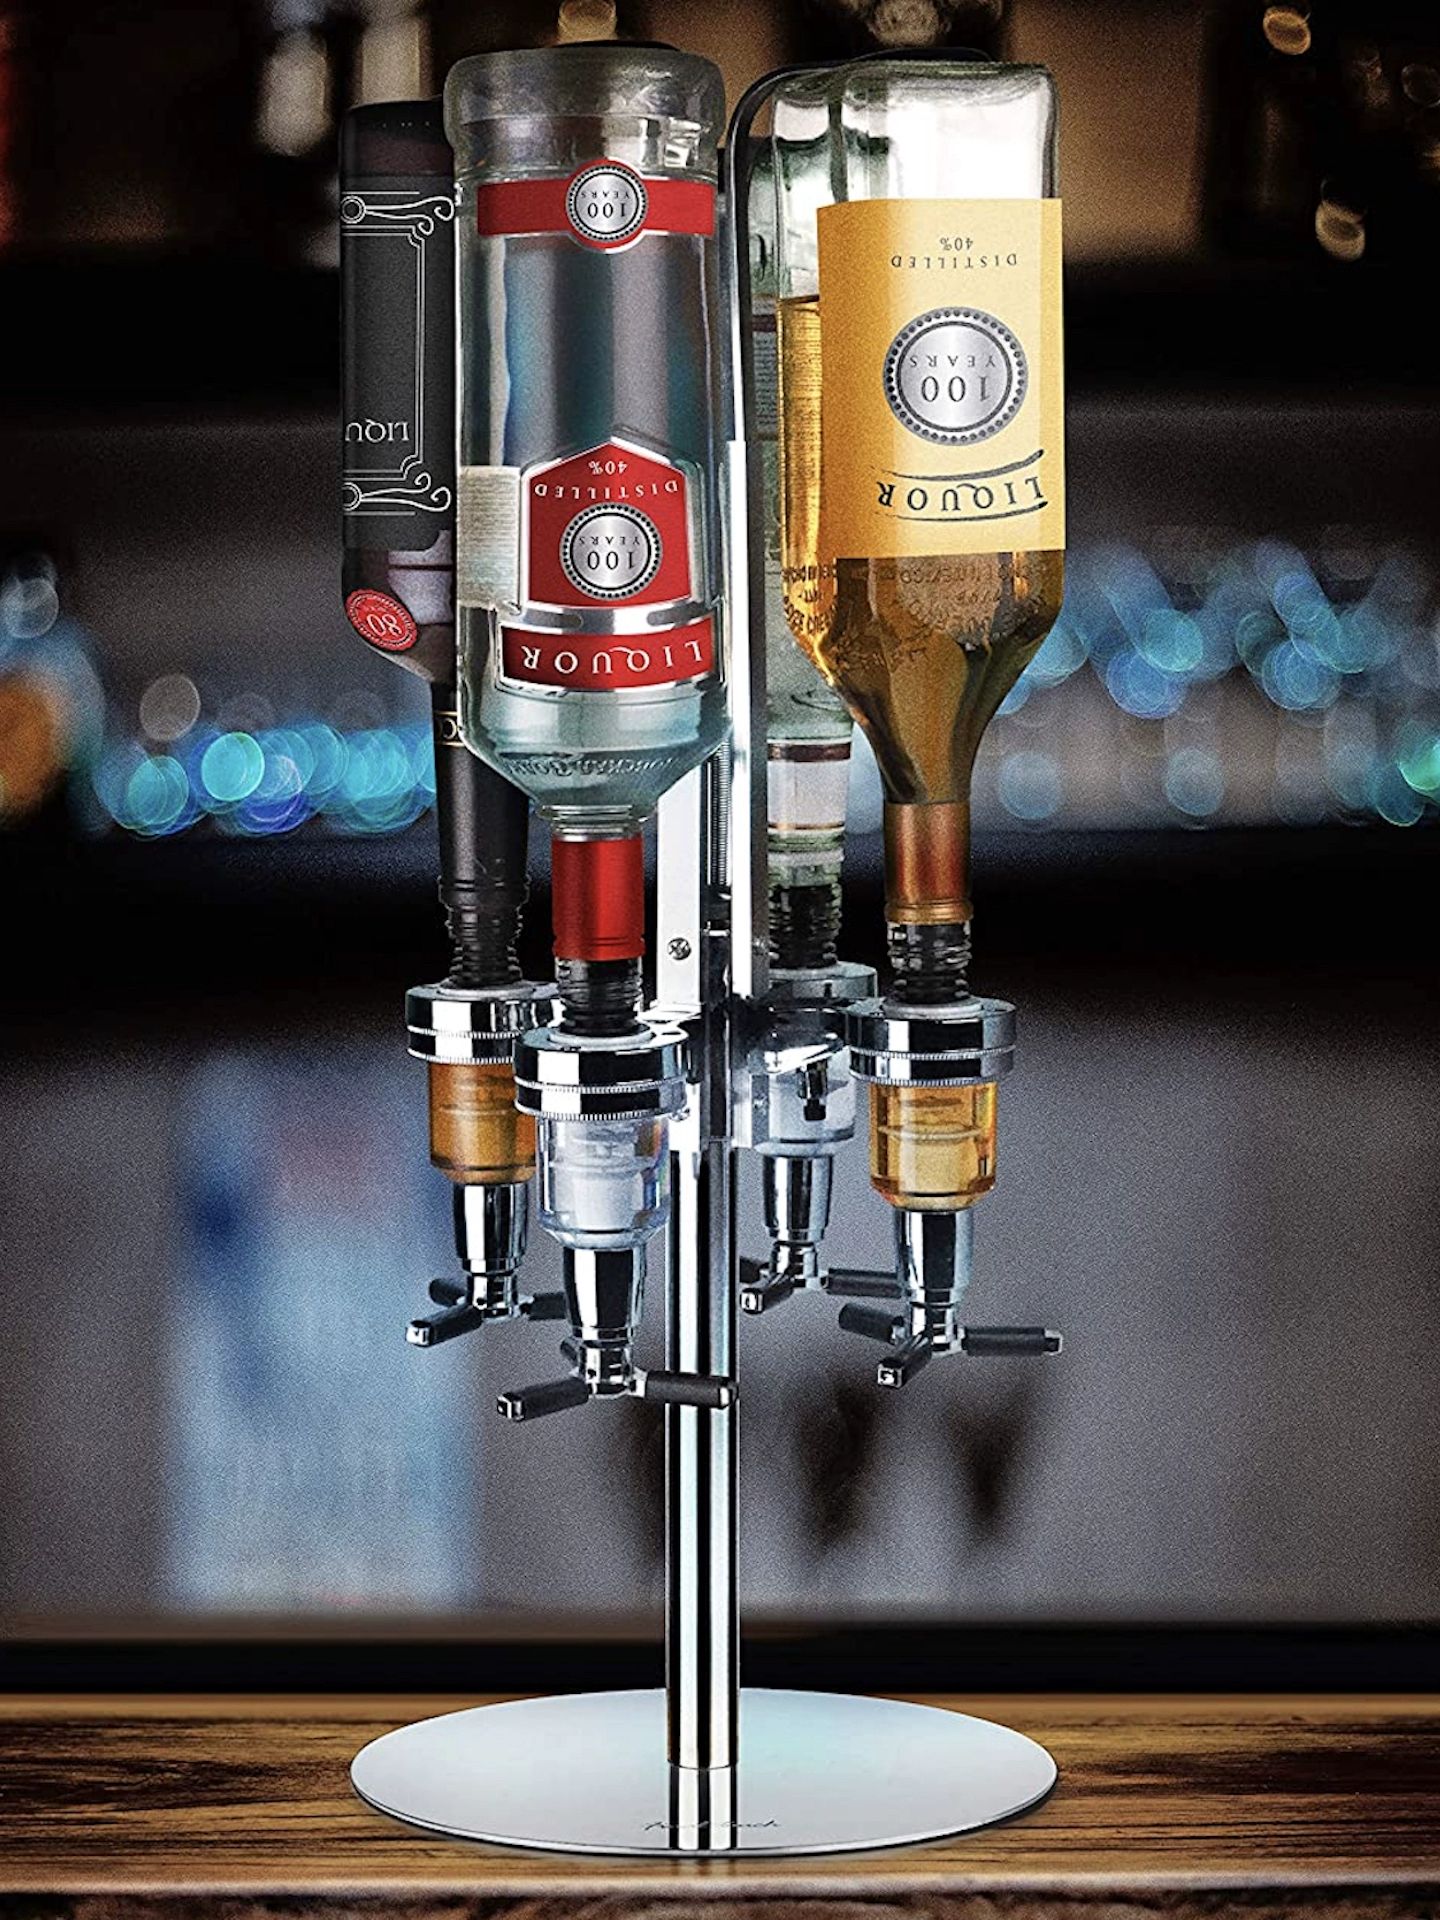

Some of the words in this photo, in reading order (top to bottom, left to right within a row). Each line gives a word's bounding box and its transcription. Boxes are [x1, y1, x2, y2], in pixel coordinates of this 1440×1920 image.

[580, 189, 630, 199] YEARS
[587, 203, 626, 218] 100
[938, 237, 974, 251] 40%
[891, 253, 1018, 269] DISTILLED
[909, 354, 996, 368] YEARS
[921, 376, 990, 402] 100
[588, 460, 628, 475] 40%
[534, 479, 679, 499] DISTILLED
[876, 476, 1044, 511] LIQUOR
[579, 536, 641, 545] YEARS
[587, 551, 636, 570] 100
[366, 613, 403, 637] 80
[521, 640, 703, 675] LIQUOR
